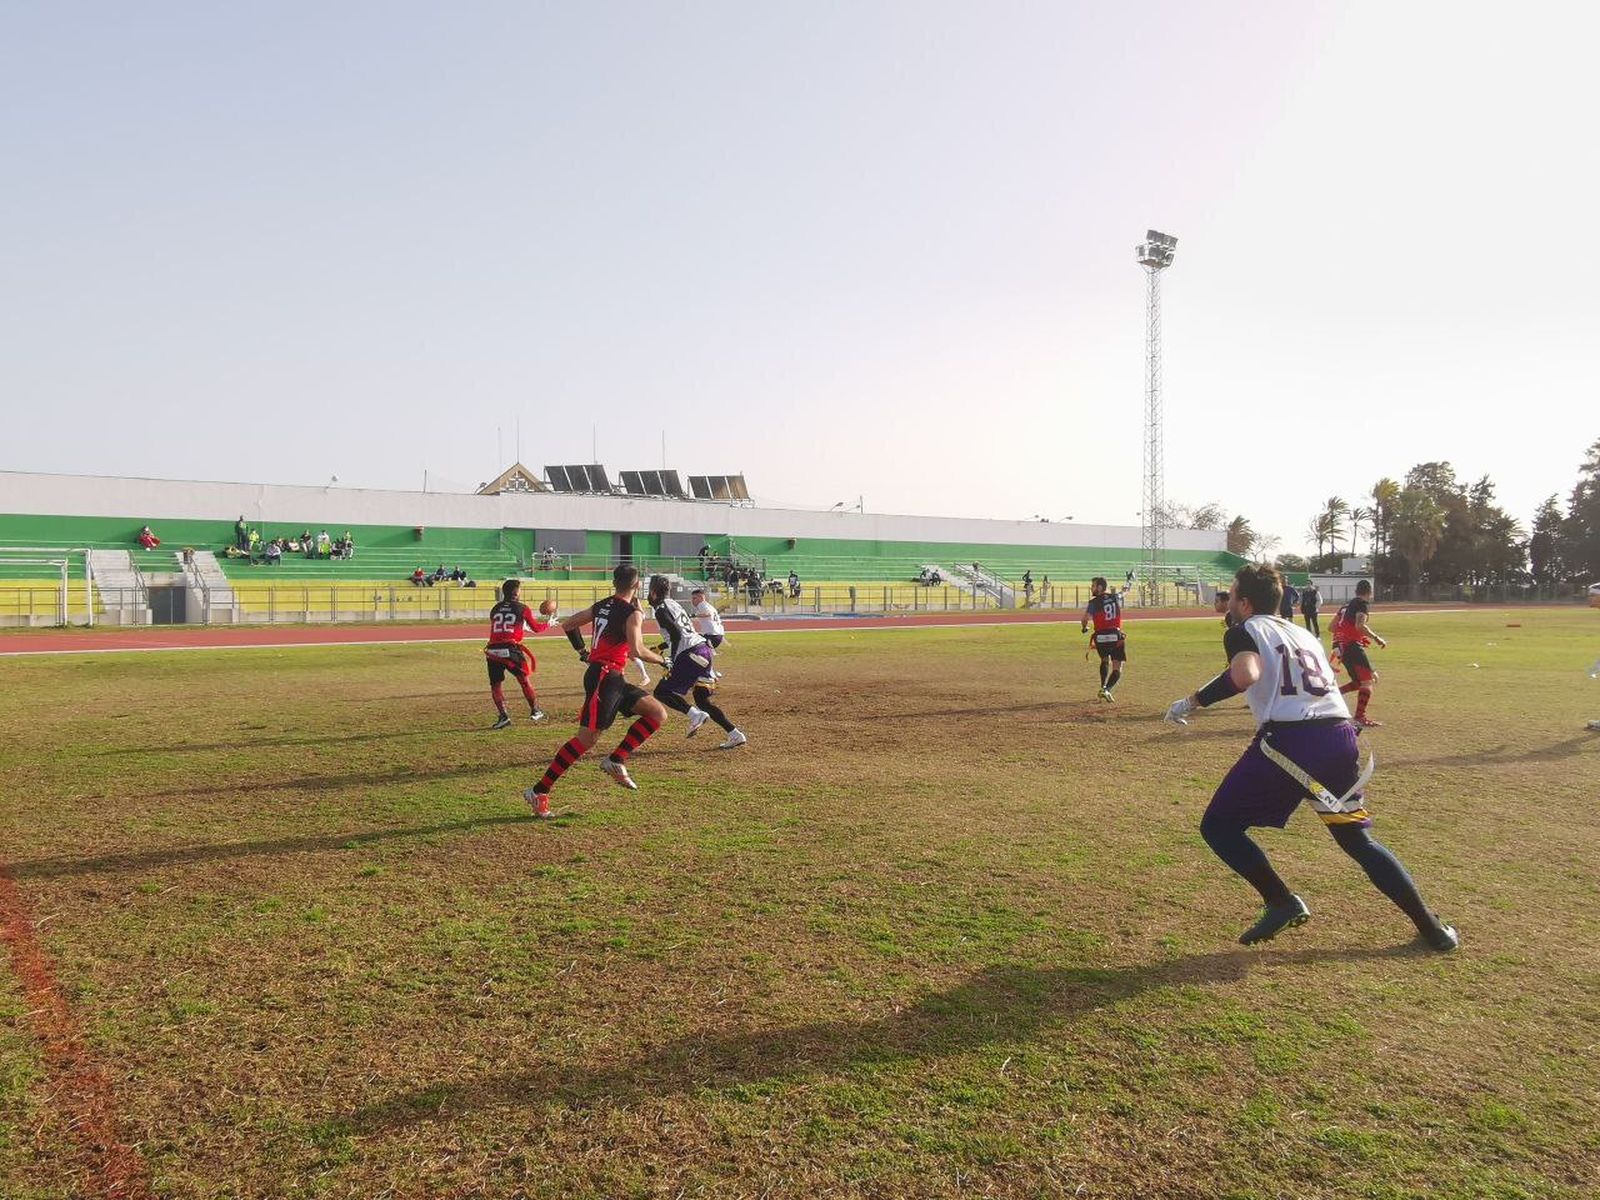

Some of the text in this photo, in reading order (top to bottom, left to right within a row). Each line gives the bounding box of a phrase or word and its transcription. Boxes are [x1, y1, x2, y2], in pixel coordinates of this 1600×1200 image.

[493, 613, 516, 633] 22
[1104, 602, 1116, 620] 81
[593, 617, 609, 649] 17
[1275, 643, 1331, 697] 18
